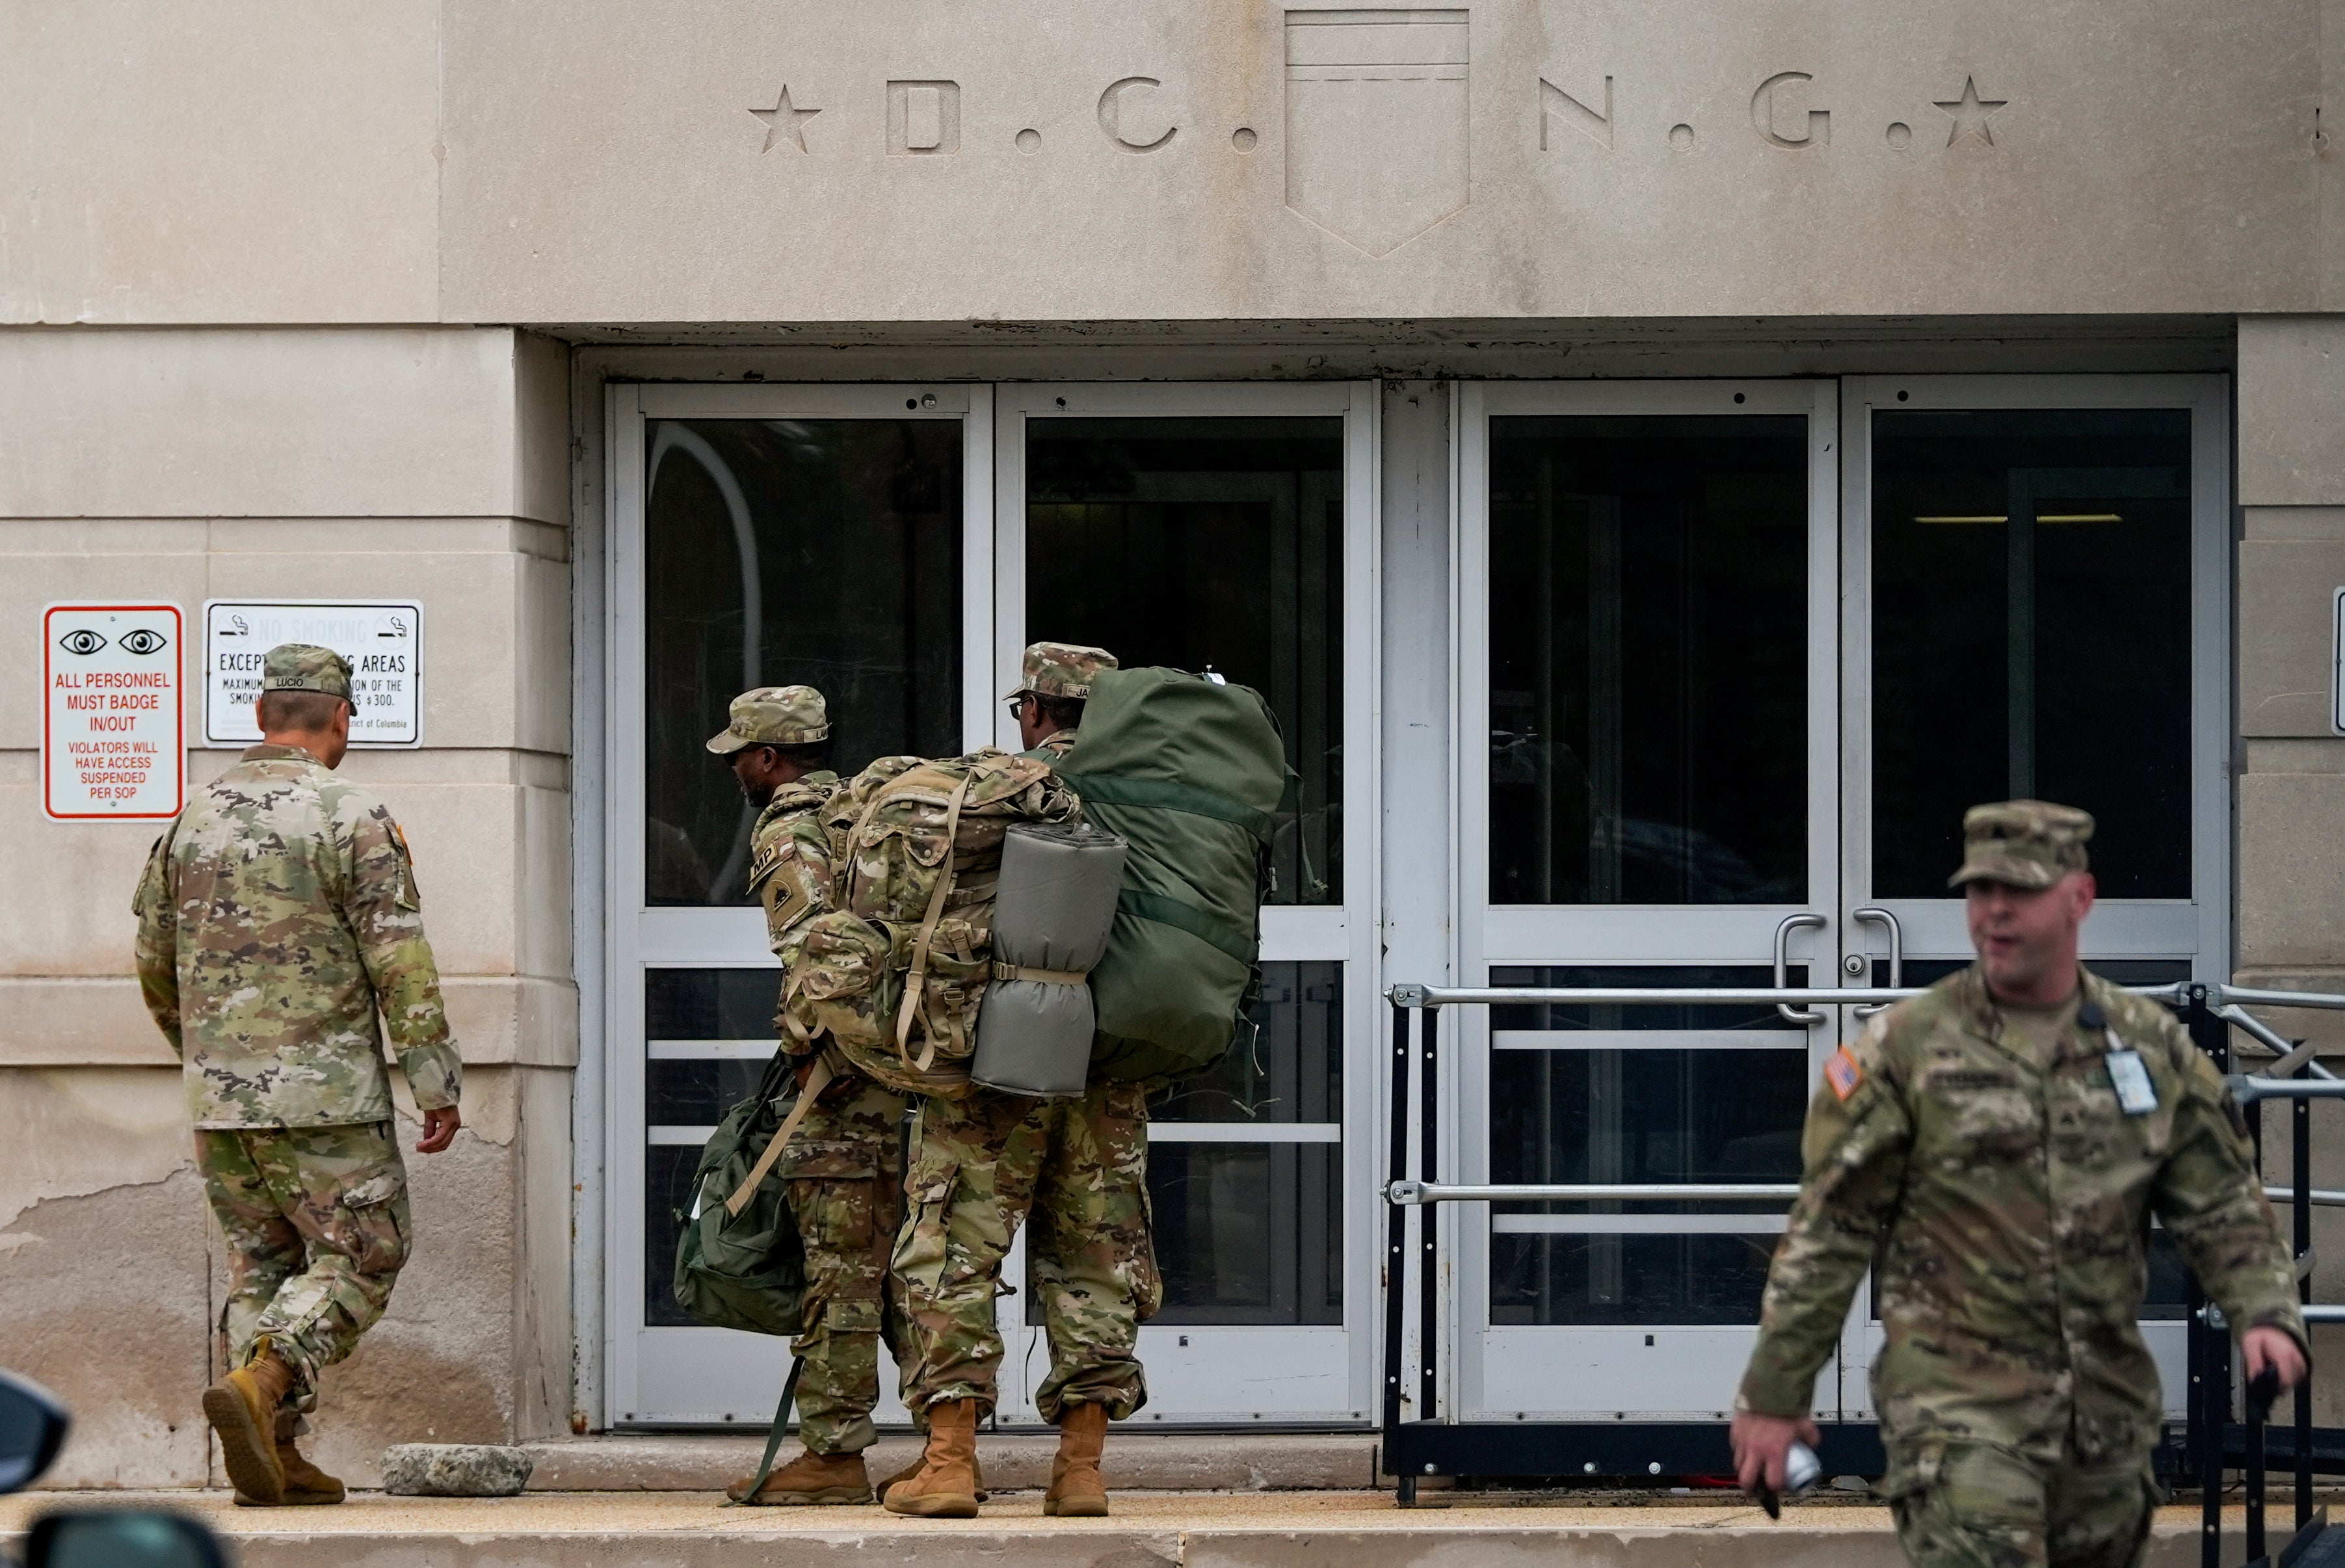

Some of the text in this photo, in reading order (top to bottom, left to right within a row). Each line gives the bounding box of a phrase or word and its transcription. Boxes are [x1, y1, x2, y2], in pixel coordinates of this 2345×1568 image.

[259, 618, 367, 643] NO SMOKING
[362, 655, 404, 672] AREAS
[55, 672, 171, 688] ALL PERSONNEL
[223, 678, 263, 689] MAXIMUM
[276, 678, 304, 687] LUCIO
[371, 680, 382, 691] OF
[387, 680, 403, 691] THE
[68, 695, 159, 710] MUST BADGE
[230, 693, 262, 704] SMOKI
[90, 717, 137, 732] IN/OUT
[366, 719, 373, 728] of
[376, 719, 407, 728] Columbia
[68, 742, 158, 753] VIOLATORS WILL
[75, 757, 151, 768] HAVE ACCESS
[81, 772, 146, 784] SUSPENDED
[90, 786, 137, 799] PER SOP
[753, 847, 773, 875] MP
